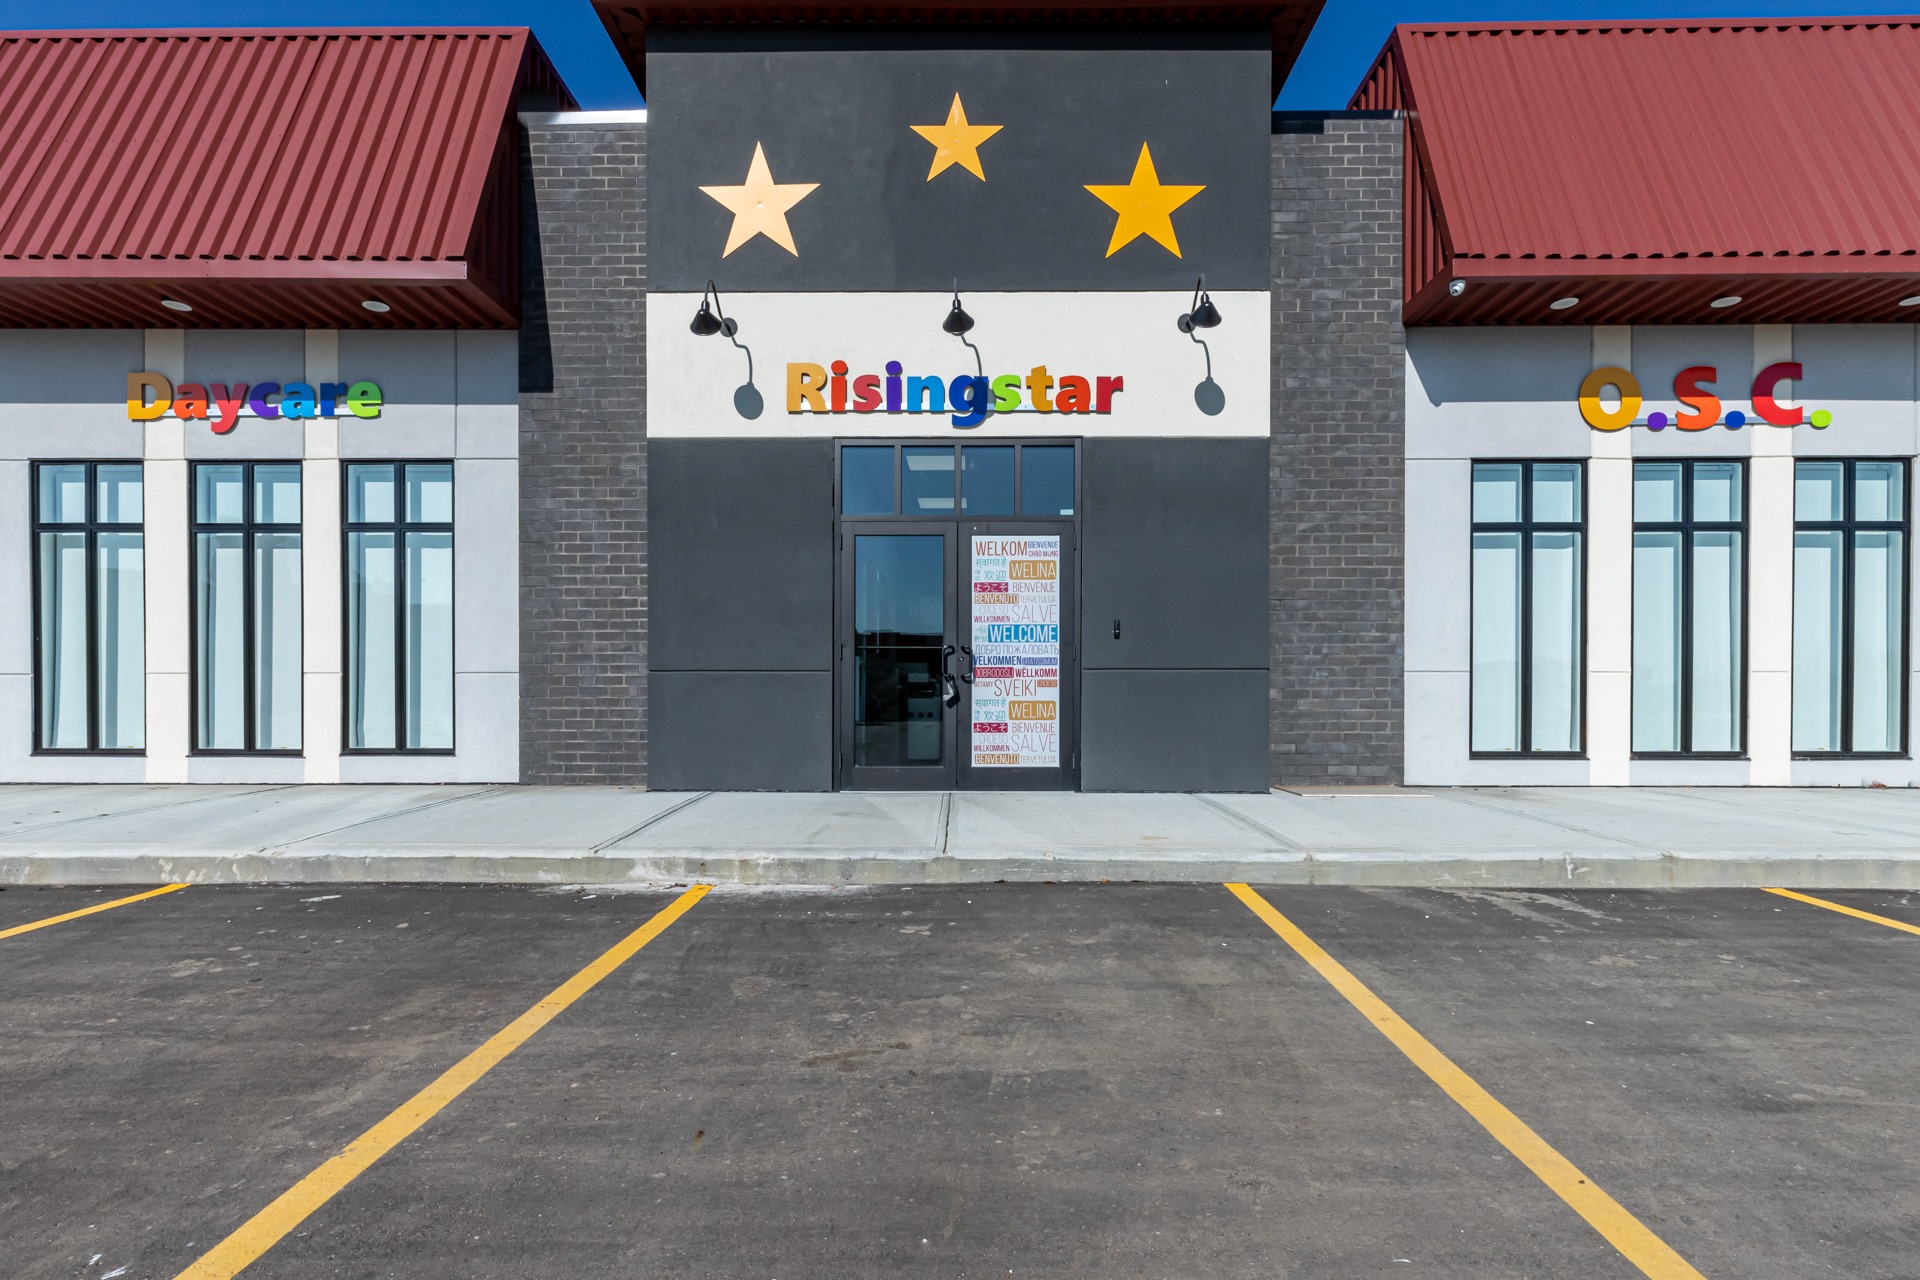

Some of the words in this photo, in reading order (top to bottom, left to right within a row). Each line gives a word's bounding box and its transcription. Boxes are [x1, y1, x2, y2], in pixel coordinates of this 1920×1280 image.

[786, 360, 1124, 428] Risingstar
[1578, 362, 1832, 431] O.S.C.
[127, 372, 382, 433] Daycare
[975, 541, 1028, 556] WELKOM
[1027, 541, 1059, 549] BIENVENUE
[1010, 562, 1056, 578] WELINA
[974, 583, 1008, 593] ようこそ
[1012, 582, 1056, 593] BIENVENUE
[975, 594, 1019, 604] BENVENUTO
[979, 605, 1009, 615] CROESO
[1011, 604, 1057, 623] SALVE
[974, 615, 1011, 623] WILLKOMMEN
[989, 625, 1057, 642] WELCOME
[974, 644, 1001, 655] ДОБРО
[1002, 644, 1059, 655] ПОЖАЛОВАТЬ
[973, 656, 1022, 665] VELKOMMEN
[1015, 667, 1057, 678] WËLLKOMM
[994, 679, 1037, 697] SVEIKI
[1010, 703, 1055, 719] WELINA
[973, 724, 1008, 733] ようこそ
[1012, 722, 1055, 733] BIENVENUE
[979, 734, 1008, 744] CROESO
[1011, 734, 1057, 752] SALVE
[975, 754, 1019, 764] BENVENUTO
[1020, 755, 1056, 764] TERVETULOA
